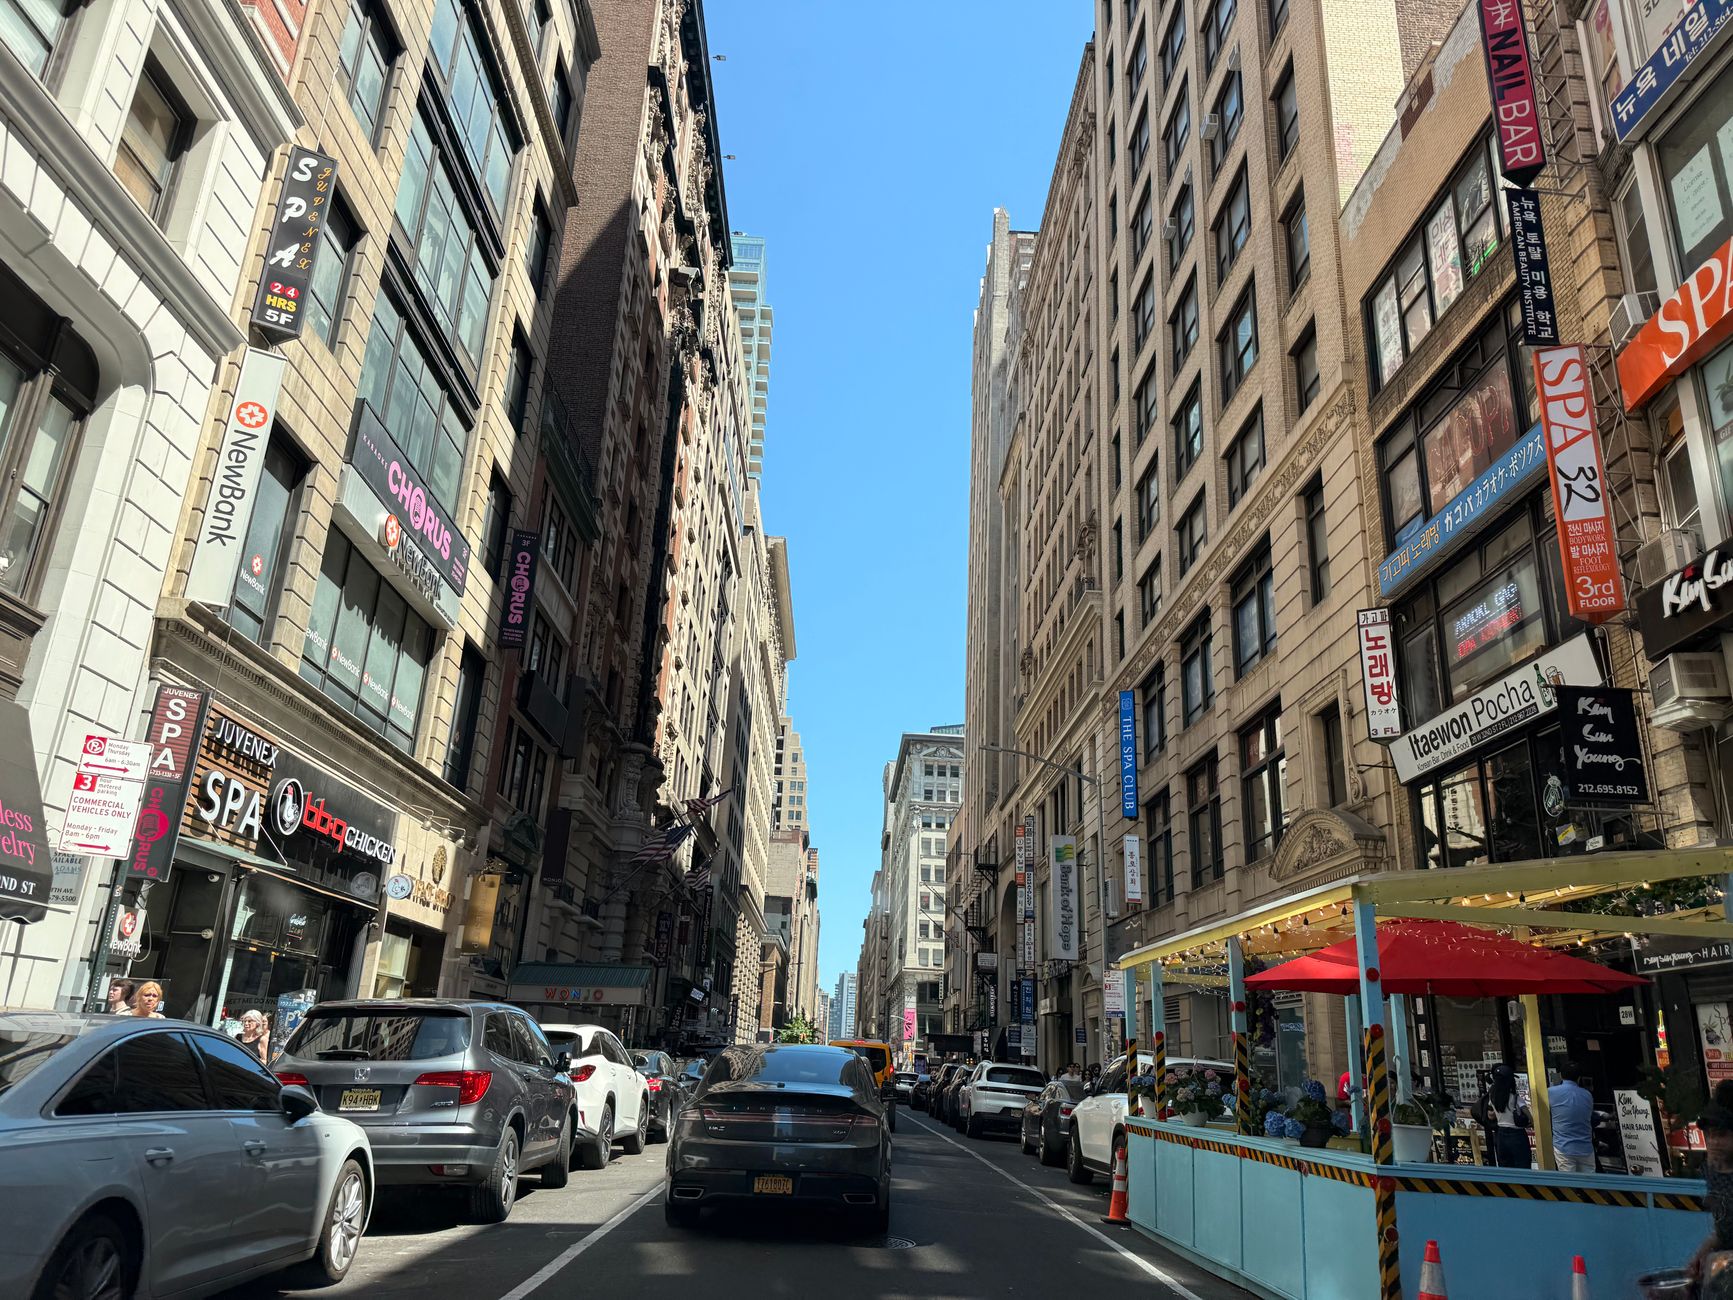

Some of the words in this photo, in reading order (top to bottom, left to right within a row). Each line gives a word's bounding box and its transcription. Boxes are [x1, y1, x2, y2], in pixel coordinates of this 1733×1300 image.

[1489, 28, 1527, 101] NAIL
[1616, 66, 1658, 122] 뉴욕
[1662, 3, 1709, 67] 네일
[1683, 46, 1698, 63] Tel:
[1499, 99, 1538, 166] BAR
[269, 157, 318, 268] SPA
[296, 167, 332, 270] JUVENEX
[1511, 201, 1527, 249] AMERICAN
[1519, 252, 1532, 287] BEAUTY
[273, 282, 297, 298] 24
[265, 294, 297, 313] HRS
[1523, 289, 1537, 336] INSTITUTE
[264, 309, 294, 325] 5F
[1540, 357, 1592, 456] SPA
[362, 433, 389, 469] KARAOKE
[206, 429, 259, 547] NewBank
[388, 460, 452, 561] CHORUS
[1583, 519, 1606, 534] 마사지
[1569, 533, 1606, 545] BODYWORK
[1570, 545, 1581, 559] 발
[1581, 542, 1609, 557] 마사지
[1382, 548, 1410, 583] 가고파
[1411, 519, 1440, 560] 노래방
[1579, 556, 1602, 566] FOOT
[398, 528, 444, 601] NewBank
[1573, 563, 1610, 575] REFLEXOLOGY
[240, 567, 266, 596] NewBank
[507, 551, 532, 625] CHORUS
[1575, 575, 1615, 598] 3rd
[1579, 596, 1616, 608] FLOOR
[1361, 610, 1388, 624] 가고파
[306, 628, 328, 651] ewBank
[336, 650, 361, 678] NewBank
[163, 687, 200, 700] JUVENEX
[367, 676, 390, 700] NewBank
[395, 698, 416, 720] NewBank
[1370, 708, 1397, 716] カラオケ
[1407, 711, 1473, 761] Itaewon
[1470, 679, 1535, 728] Pocha
[1577, 697, 1614, 724] Kim
[152, 698, 188, 771] SPA
[1122, 716, 1132, 741] THE
[1371, 728, 1379, 736] 3
[1582, 724, 1614, 743] Sun
[215, 717, 280, 769] JUVENEX
[1123, 746, 1133, 770] SPA
[1416, 759, 1433, 772] Korean
[1440, 748, 1453, 761] Drink
[1457, 740, 1470, 753] Food
[1574, 745, 1641, 771] Young
[80, 775, 93, 790] 3
[96, 788, 118, 797] parking
[98, 783, 122, 791] metered
[1124, 775, 1135, 810] CLUB
[1577, 784, 1639, 795] 212.695.8152
[71, 805, 110, 816] VEHICLES
[111, 810, 132, 819] ONLY
[73, 796, 125, 810] COMMERCIAL
[199, 770, 261, 841] SPA
[64, 829, 80, 837] 8am
[85, 832, 100, 840] 6pm
[66, 822, 93, 833] Monday
[98, 826, 118, 836] Friday
[133, 787, 170, 872] CHORUS
[0, 830, 36, 866] elry
[345, 826, 397, 865] CHICKEN
[0, 873, 17, 892] ND
[20, 879, 37, 896] ST
[1059, 864, 1073, 897] Bank
[1060, 897, 1074, 913] of
[1058, 913, 1074, 952] Hope
[1701, 944, 1731, 959] HAIR
[545, 986, 604, 1000] WONJO
[1621, 1010, 1633, 1019] 28W
[1617, 1092, 1633, 1106] Kim
[1631, 1104, 1650, 1119] Young
[1621, 1123, 1635, 1131] HAIR
[1635, 1123, 1653, 1131] SALON
